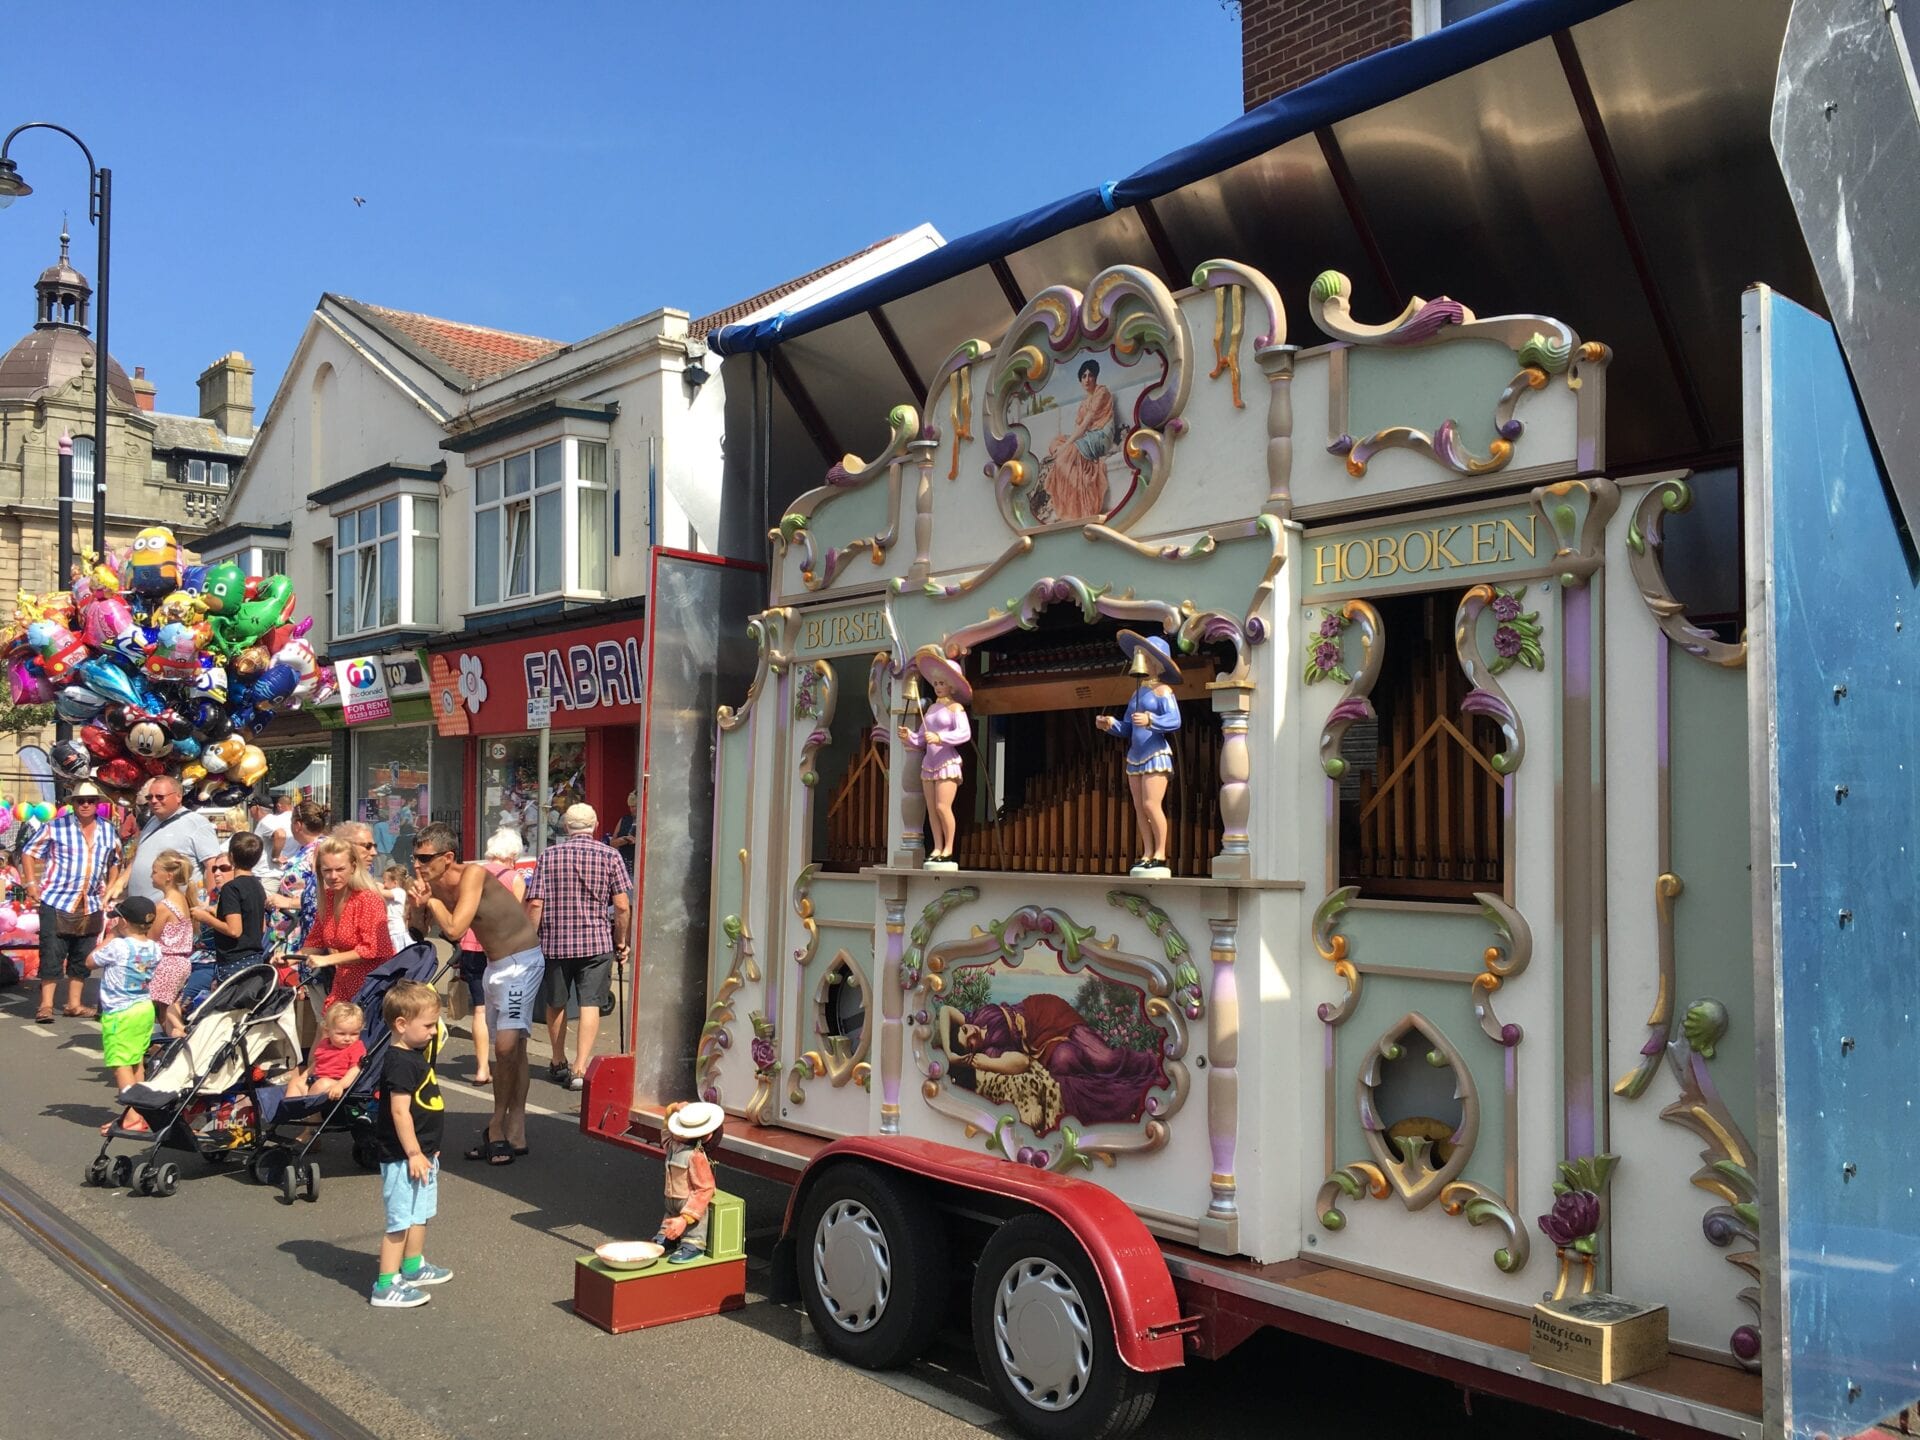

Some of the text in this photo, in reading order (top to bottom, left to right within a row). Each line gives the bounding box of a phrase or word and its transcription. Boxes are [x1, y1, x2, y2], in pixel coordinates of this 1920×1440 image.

[1312, 514, 1537, 586] HOBOKEN
[523, 637, 644, 712] FABRI
[347, 700, 388, 714] FOR RENT
[509, 990, 523, 1019] NIKE
[215, 1114, 249, 1130] hauck
[1532, 1314, 1592, 1346] American
